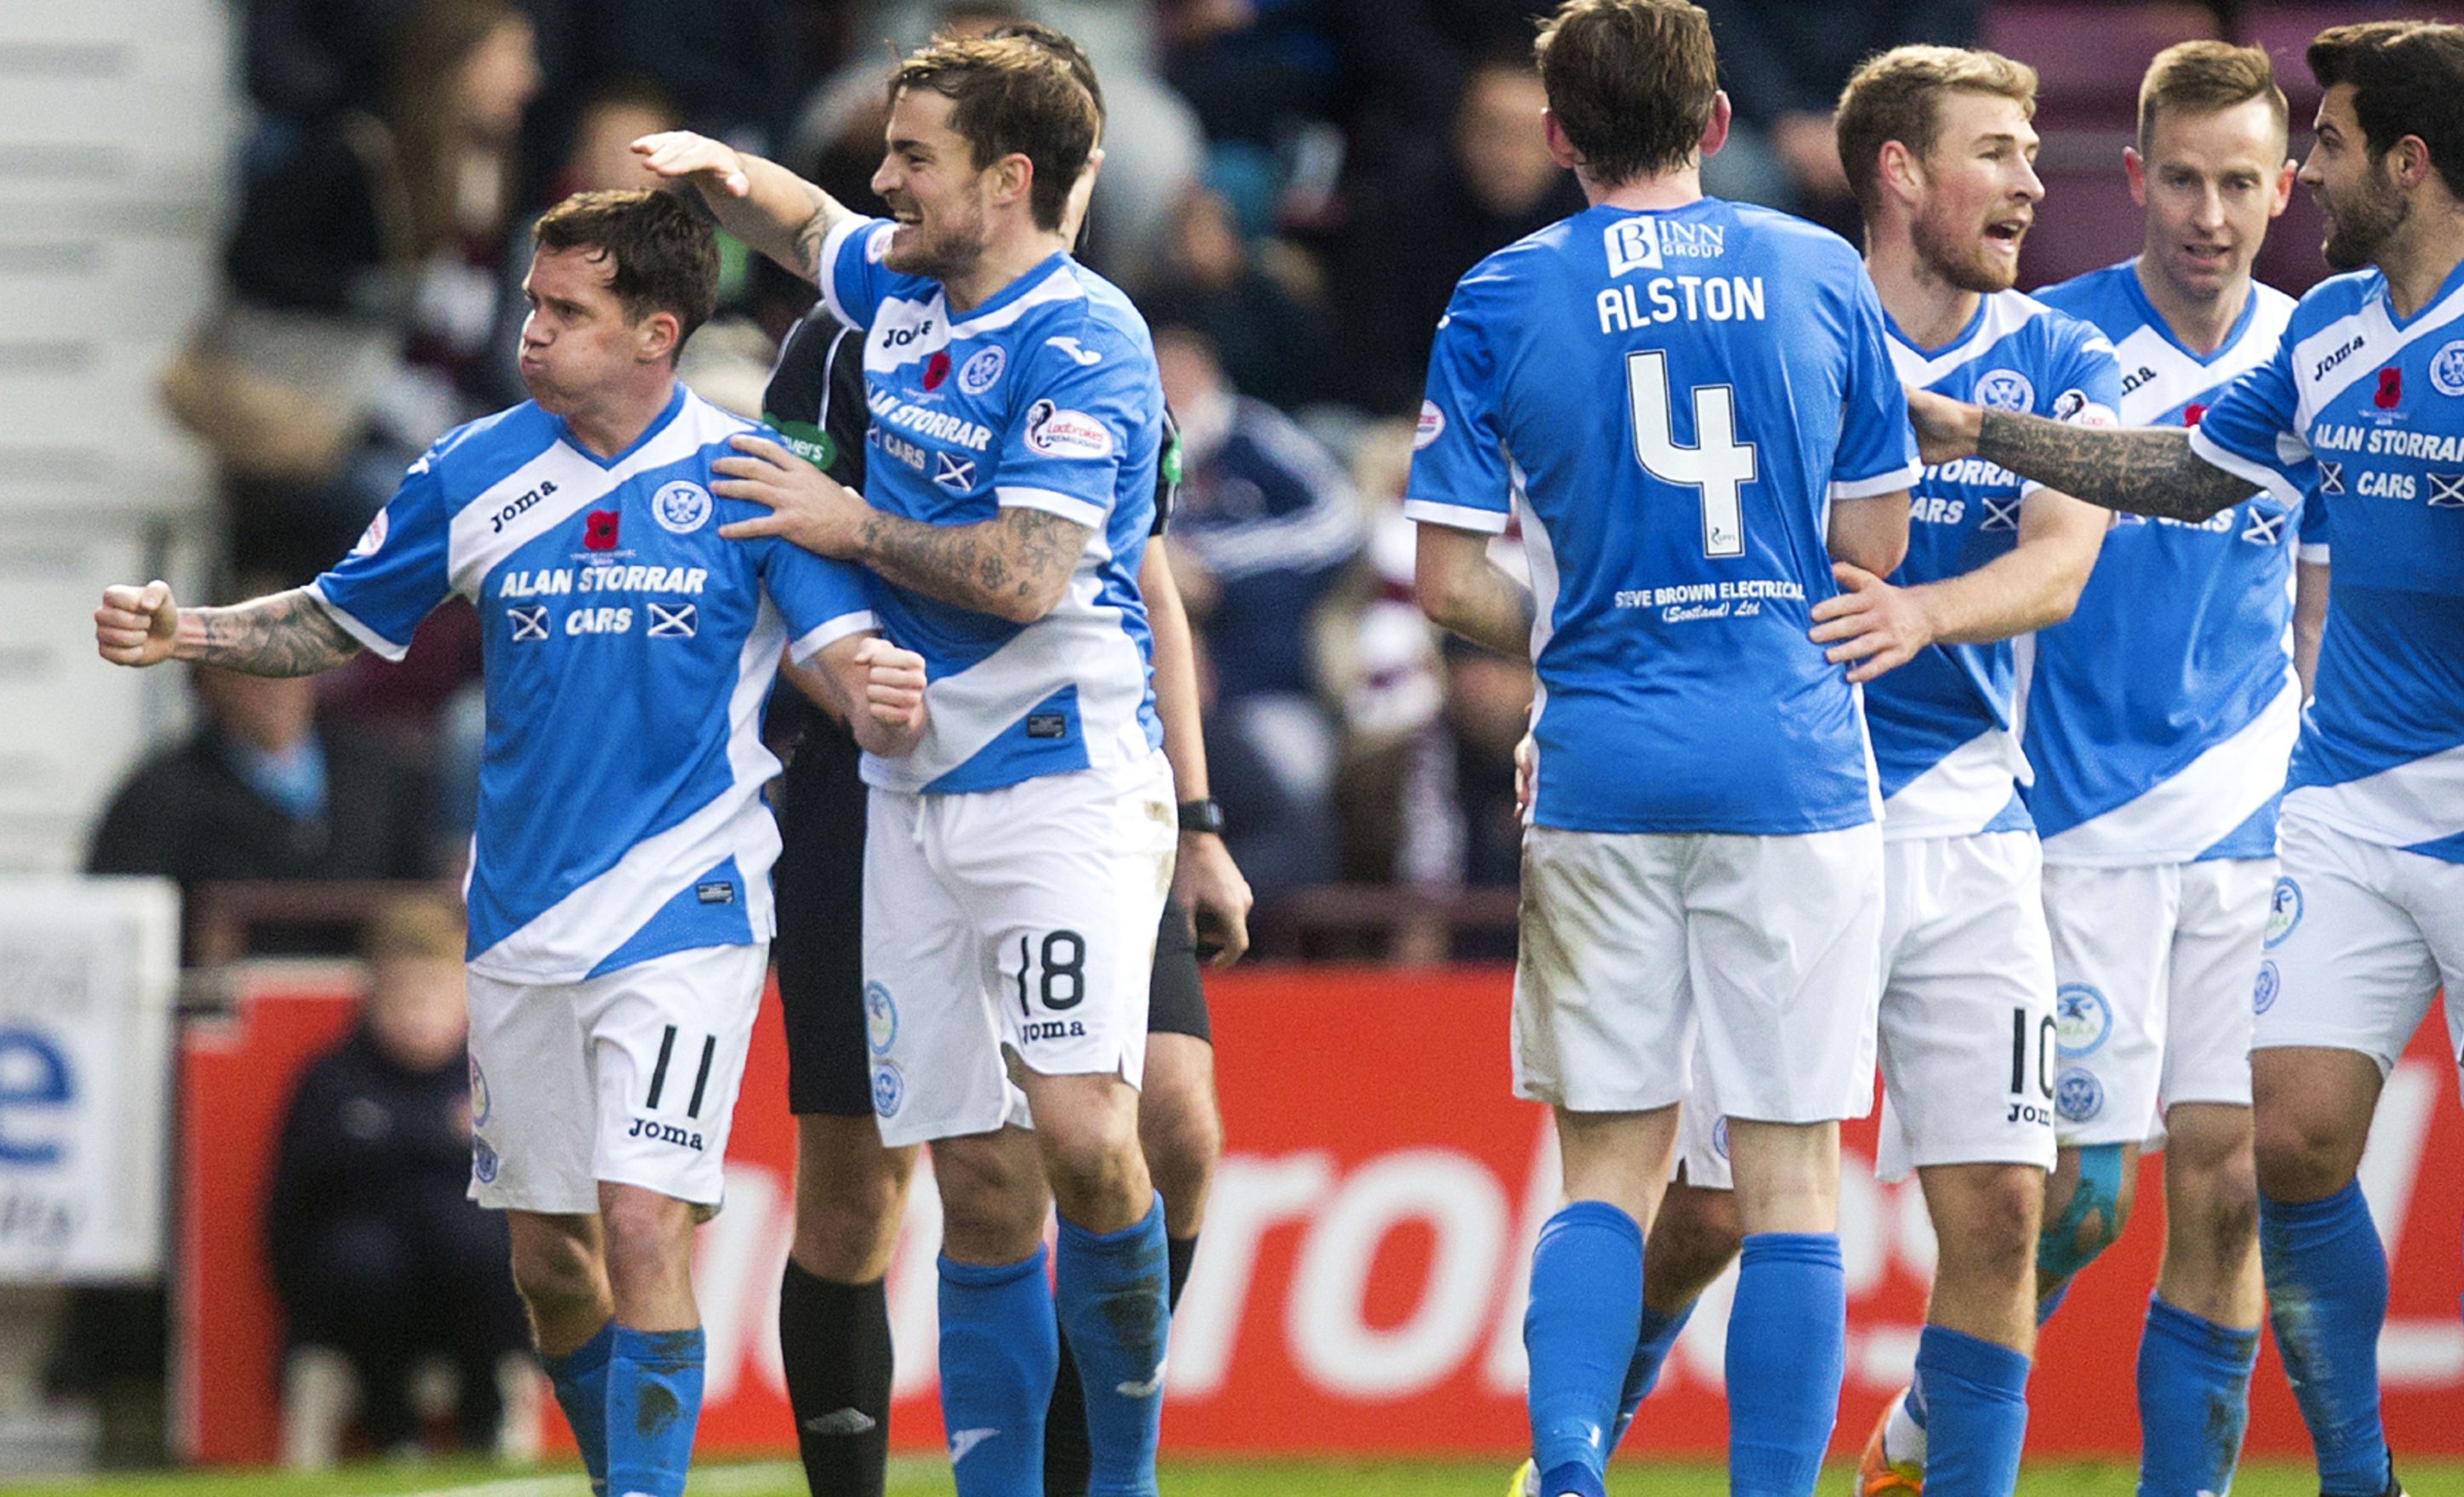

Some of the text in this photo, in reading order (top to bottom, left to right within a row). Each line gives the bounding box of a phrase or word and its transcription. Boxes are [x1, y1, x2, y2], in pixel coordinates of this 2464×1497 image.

[1662, 242, 1725, 259] GROUP
[1596, 275, 1765, 335] ALSTON
[888, 404, 993, 452] STORRAR
[2313, 424, 2365, 452] ALAN
[883, 433, 927, 470] CARS
[1624, 348, 1759, 559] 4
[2356, 470, 2417, 500] CARS
[490, 480, 559, 534] Joma
[1908, 496, 1966, 525] ARS
[499, 565, 709, 598] ALAN STORRAR
[1654, 583, 1717, 606] BROWN
[565, 606, 634, 636] CARS
[1661, 601, 1761, 623] (Scotland) Ltd
[1017, 929, 1087, 1017] 18
[646, 1023, 717, 1120] 11
[628, 1118, 704, 1152] Joma
